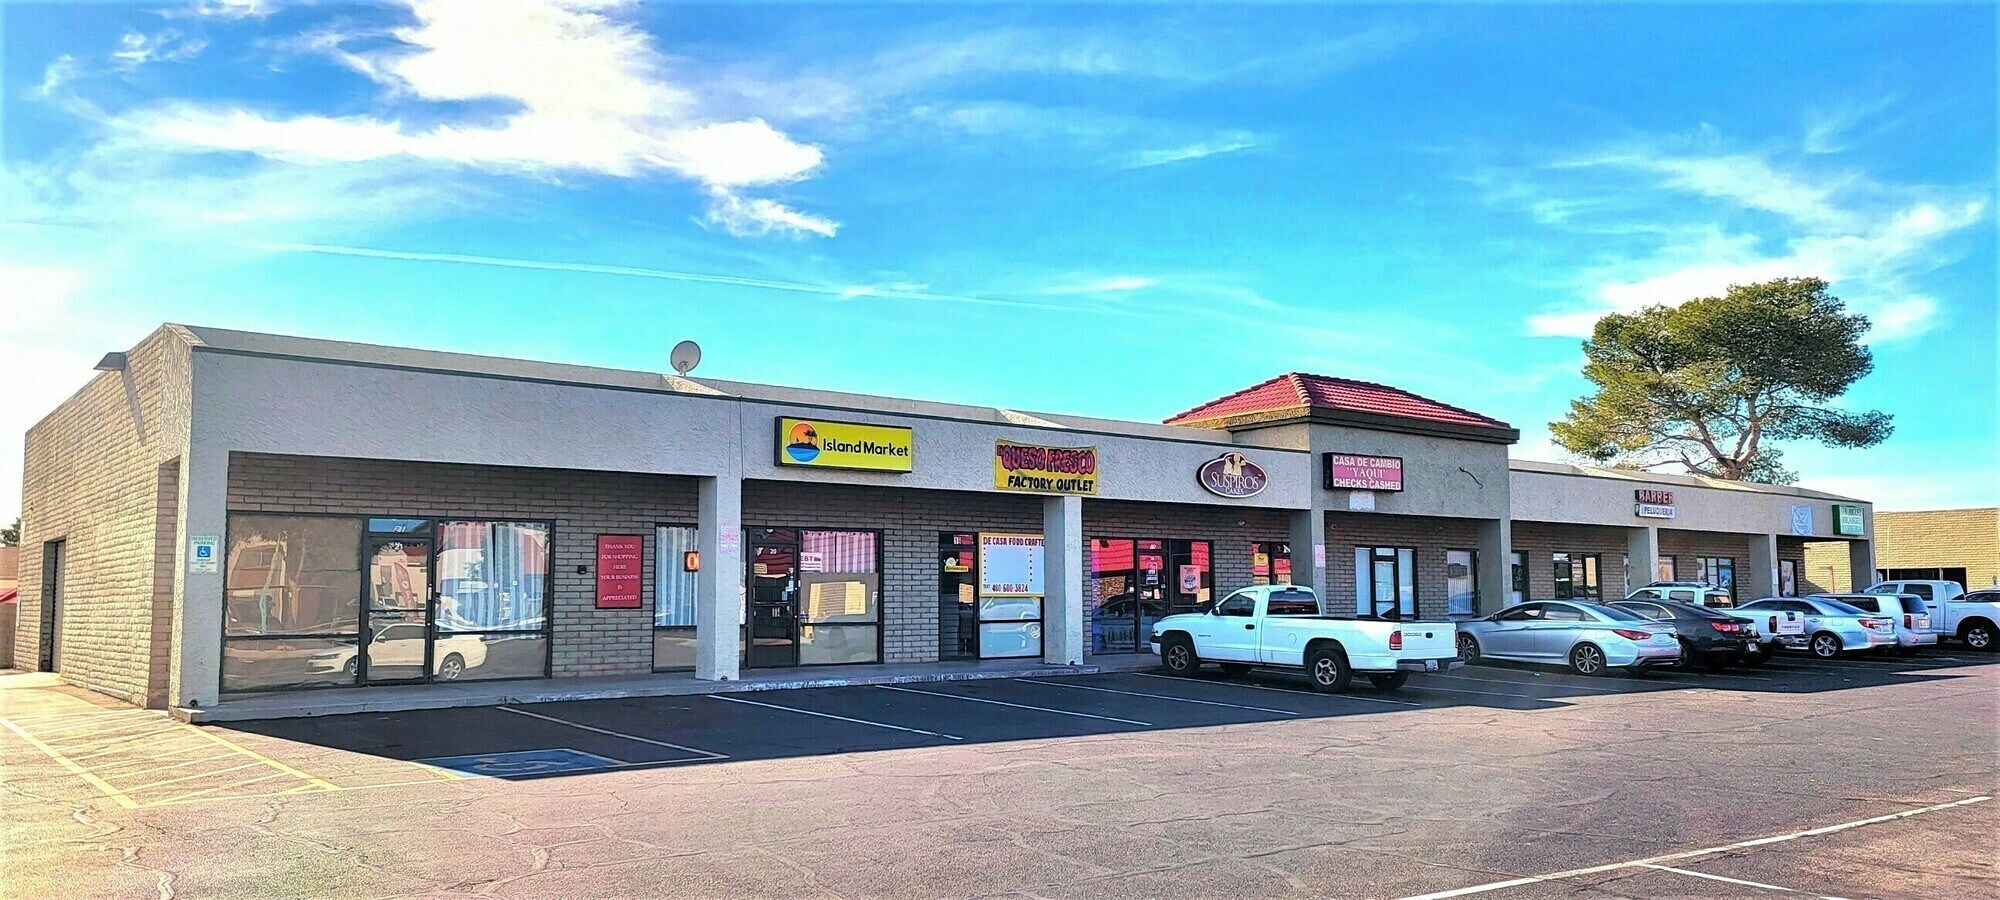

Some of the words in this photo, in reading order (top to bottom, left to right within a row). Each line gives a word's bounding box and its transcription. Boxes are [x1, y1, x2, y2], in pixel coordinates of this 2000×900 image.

[823, 438, 861, 453] Island
[863, 441, 908, 457] Market
[1001, 444, 1046, 472] QUESO
[1046, 448, 1095, 475] FRESCO
[1333, 456, 1356, 466] CASA
[1357, 457, 1368, 467] DE
[1370, 459, 1401, 469] CAMBIO
[1008, 475, 1053, 490] FACTORY
[1056, 478, 1094, 492] OUTLET
[1211, 471, 1259, 490] SUSPIROS
[1333, 478, 1367, 488] CHECKS
[1369, 480, 1401, 490] CASHED
[1639, 490, 1674, 504] BARBER
[983, 537, 992, 545] DE
[992, 537, 1008, 545] CASA
[1009, 538, 1024, 546] FOOD
[992, 584, 1002, 592] 480
